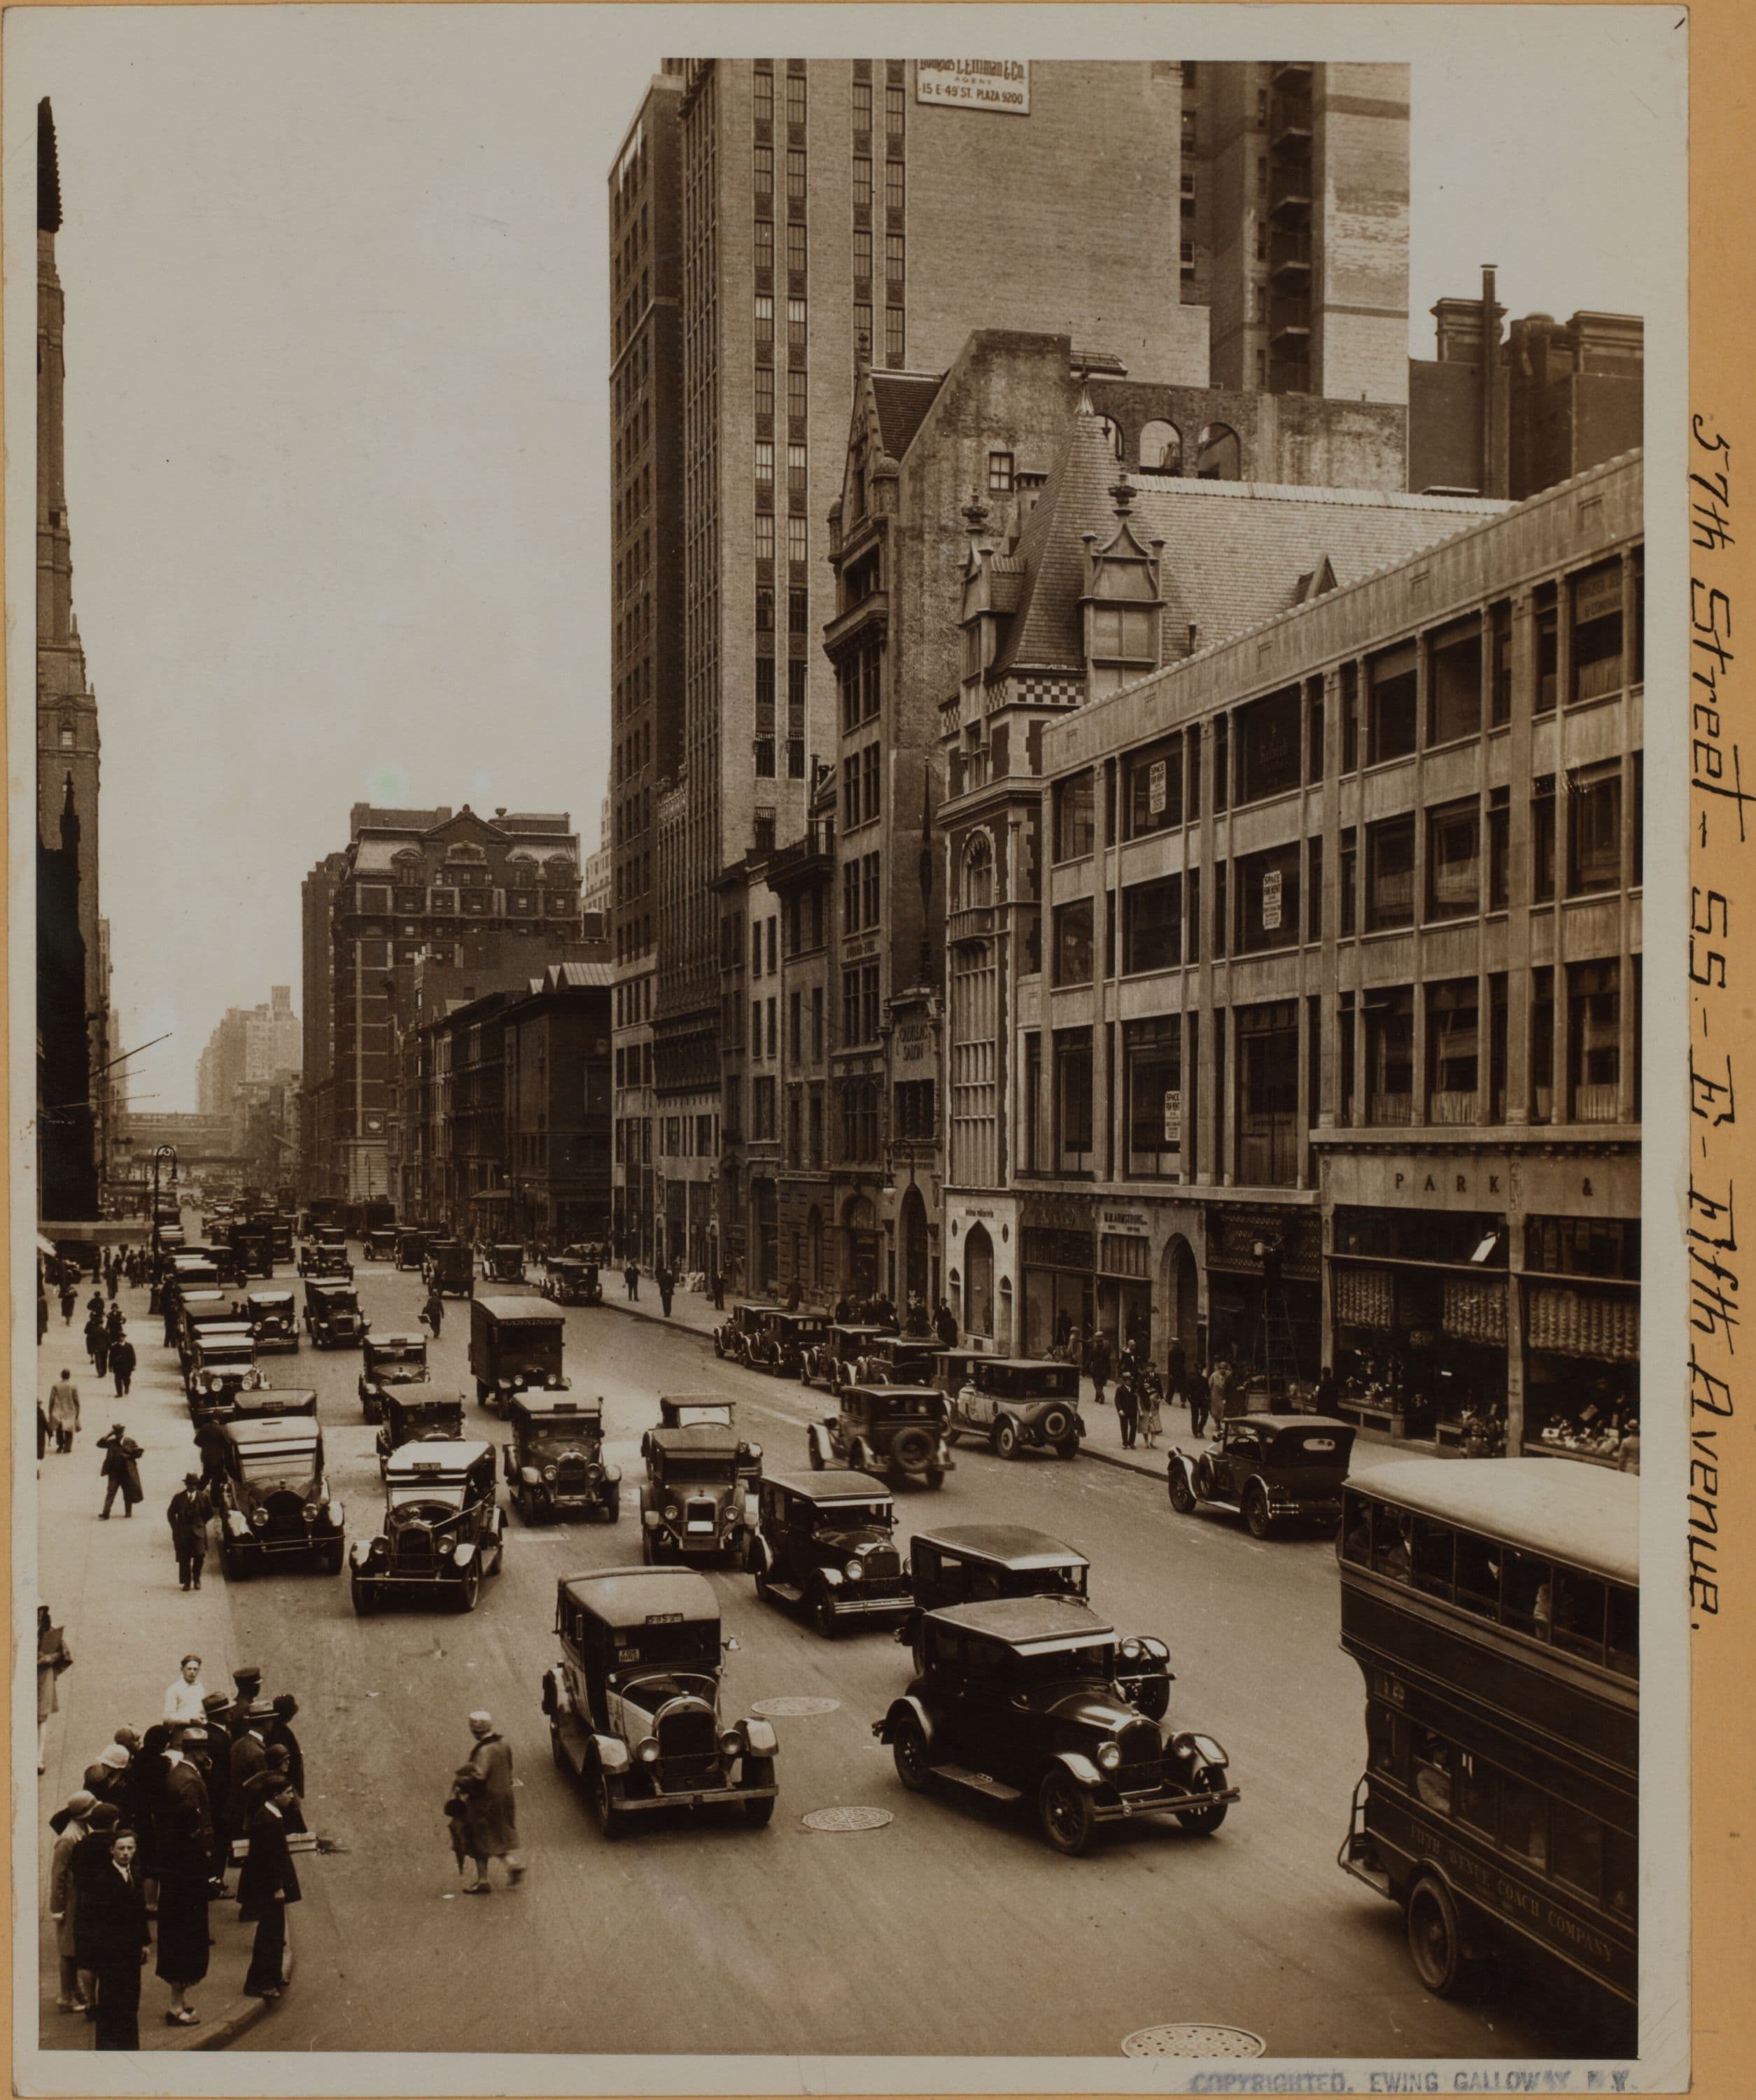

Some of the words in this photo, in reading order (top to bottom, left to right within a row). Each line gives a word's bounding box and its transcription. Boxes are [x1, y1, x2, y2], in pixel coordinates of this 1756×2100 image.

[953, 76, 992, 85] AGENT
[976, 89, 1000, 101] PLAZA
[1002, 92, 1023, 105] 9200
[1690, 414, 1735, 549] 57th
[1151, 763, 1164, 775] SPACE
[1265, 873, 1280, 885] SPACE
[903, 1042, 924, 1061] SALON
[1166, 1093, 1179, 1101] SPACE
[1396, 1174, 1500, 1193] PARK
[1582, 1177, 1592, 1196] &
[1687, 1172, 1740, 1353] Fifth
[1410, 1825, 1440, 1855] FIFTH
[1497, 1879, 1540, 1917] COACH
[1547, 1910, 1613, 1962] COMPANY
